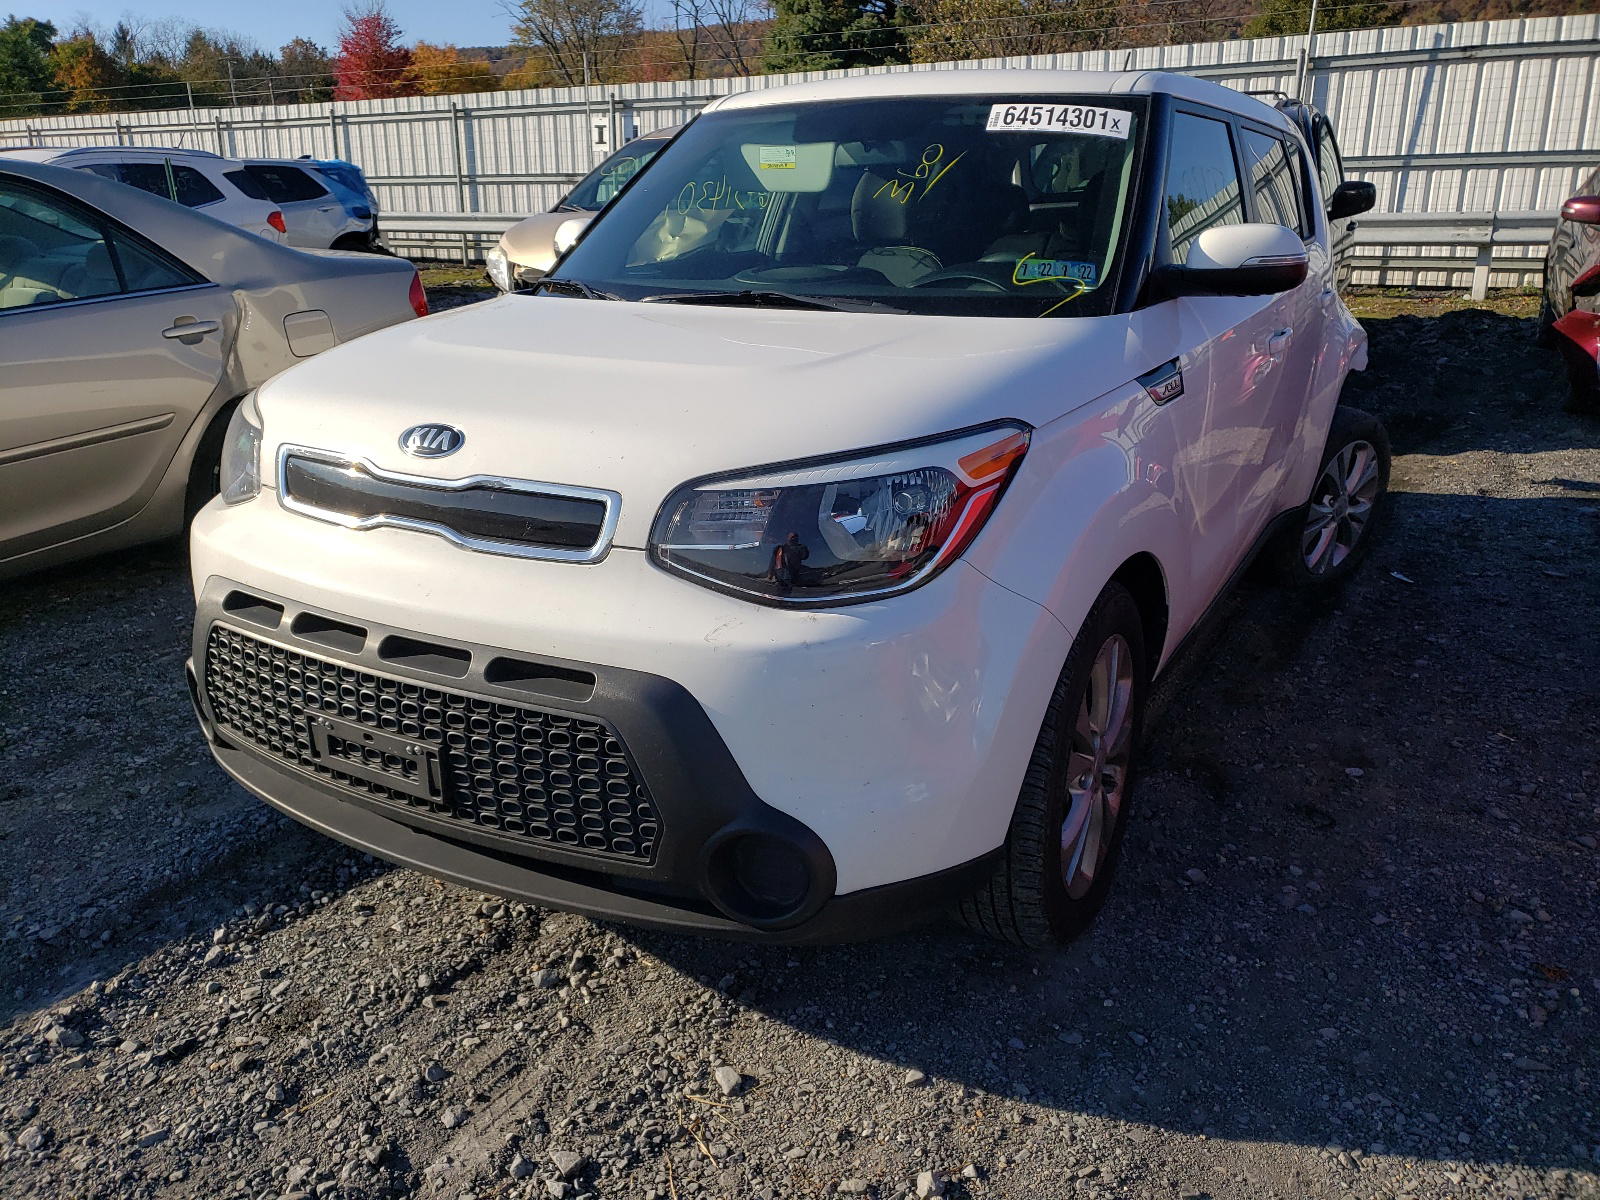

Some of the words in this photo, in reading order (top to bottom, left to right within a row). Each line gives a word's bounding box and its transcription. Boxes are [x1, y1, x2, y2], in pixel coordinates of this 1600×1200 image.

[1003, 105, 1109, 130] 64514301
[1040, 262, 1052, 277] 22
[1080, 264, 1092, 280] 22
[406, 427, 452, 451] KIA
